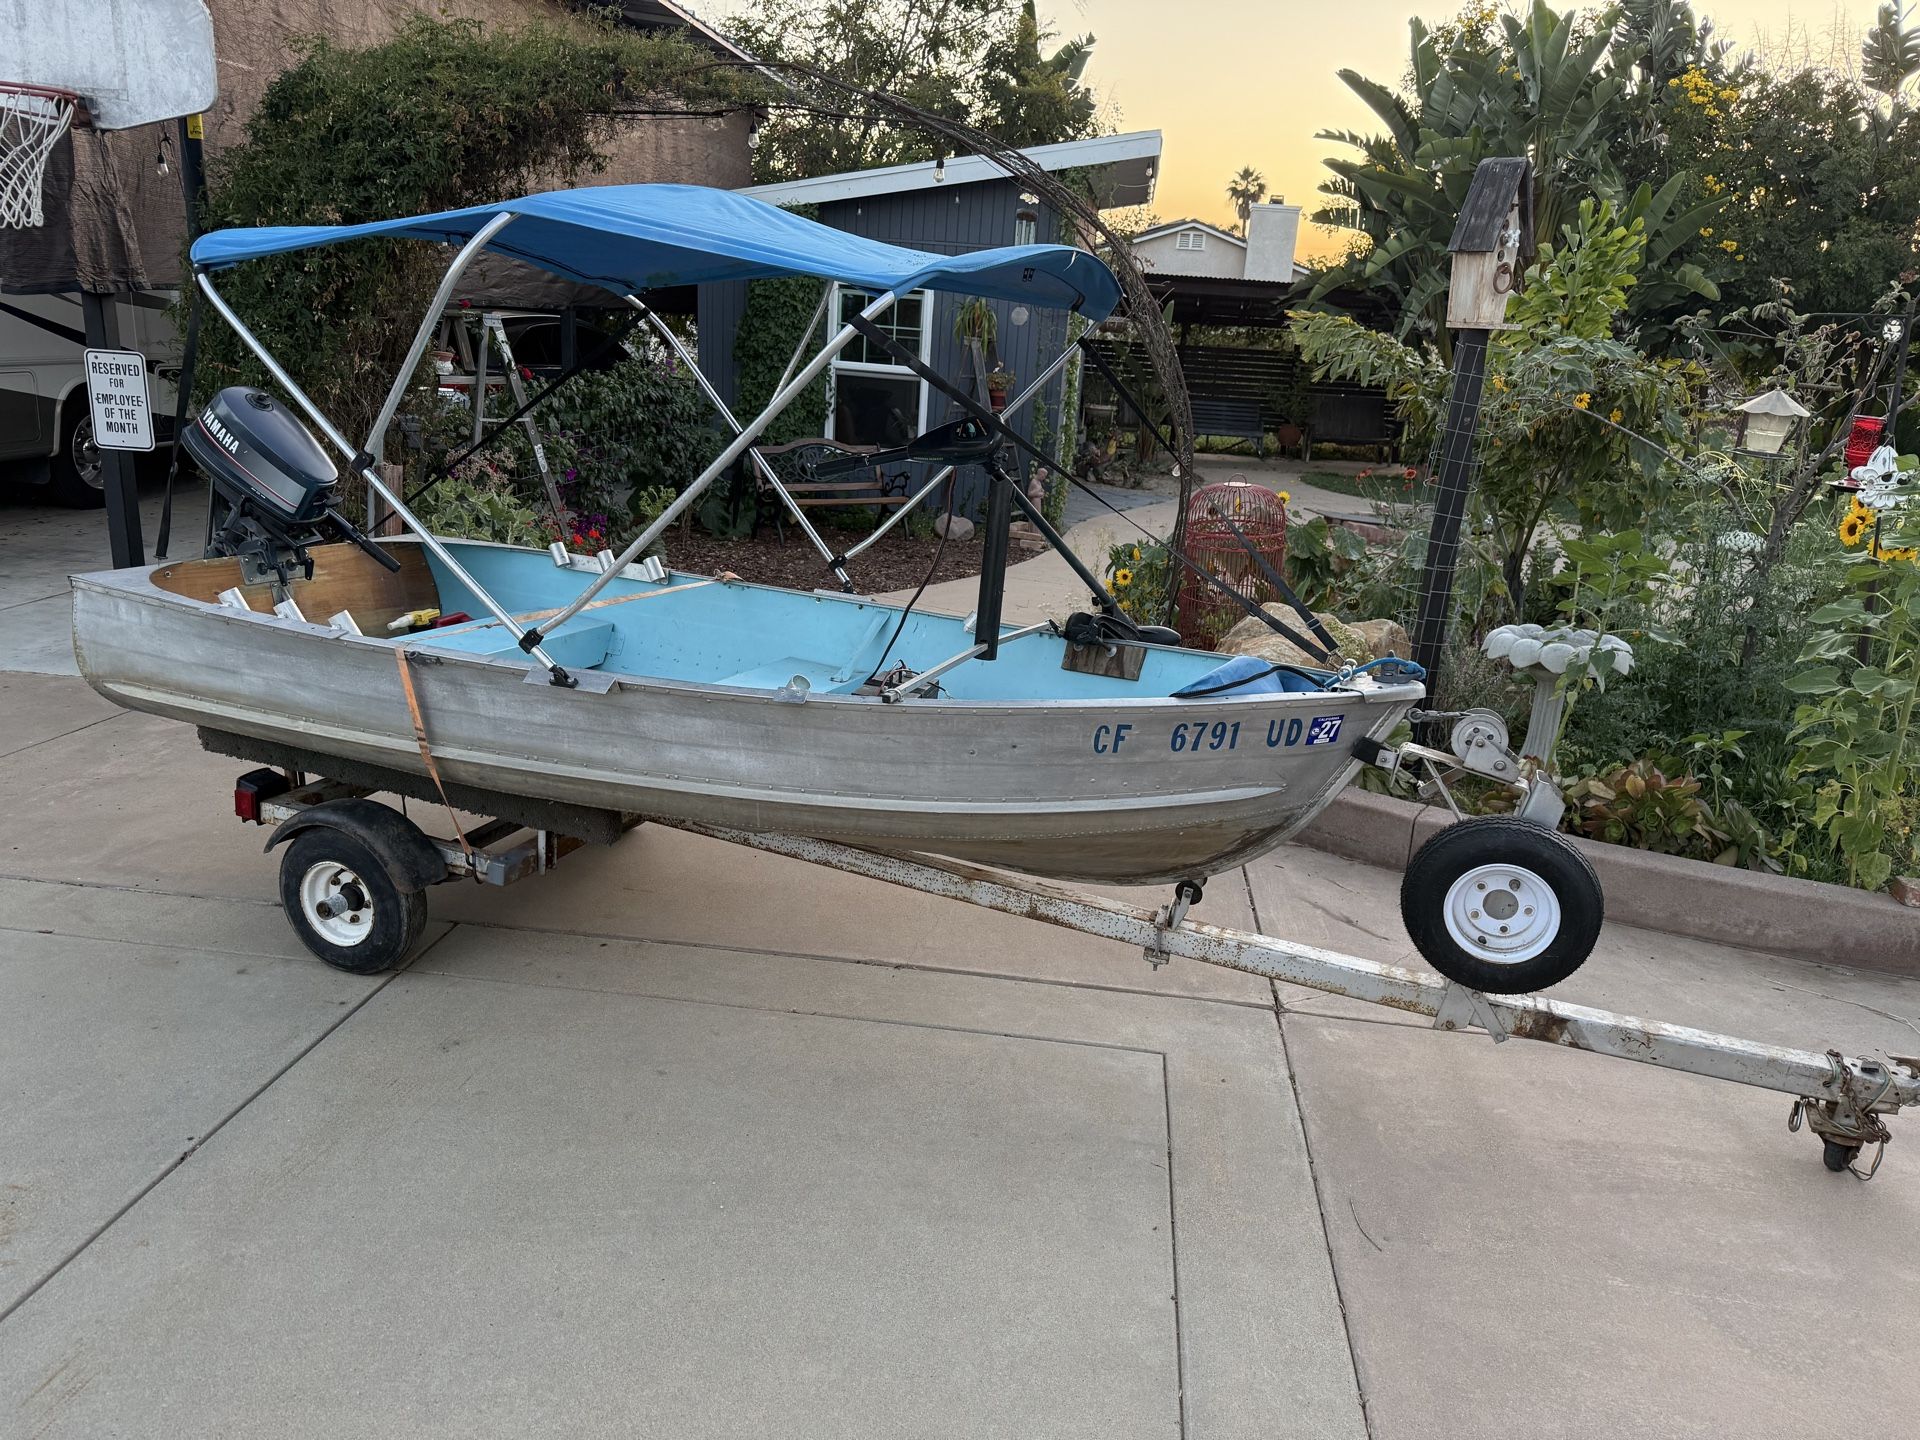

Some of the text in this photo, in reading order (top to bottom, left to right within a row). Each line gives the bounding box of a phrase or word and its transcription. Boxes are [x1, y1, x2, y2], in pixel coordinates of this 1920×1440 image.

[91, 361, 140, 377] RESERVED
[109, 378, 125, 389] FOR
[95, 393, 144, 407] EMPLOYEE
[104, 407, 137, 420] OF THE
[105, 421, 139, 434] MONTH
[202, 407, 240, 454] YAMAHA
[1093, 718, 1303, 754] CF 6791 UD
[1317, 720, 1342, 739] 27
